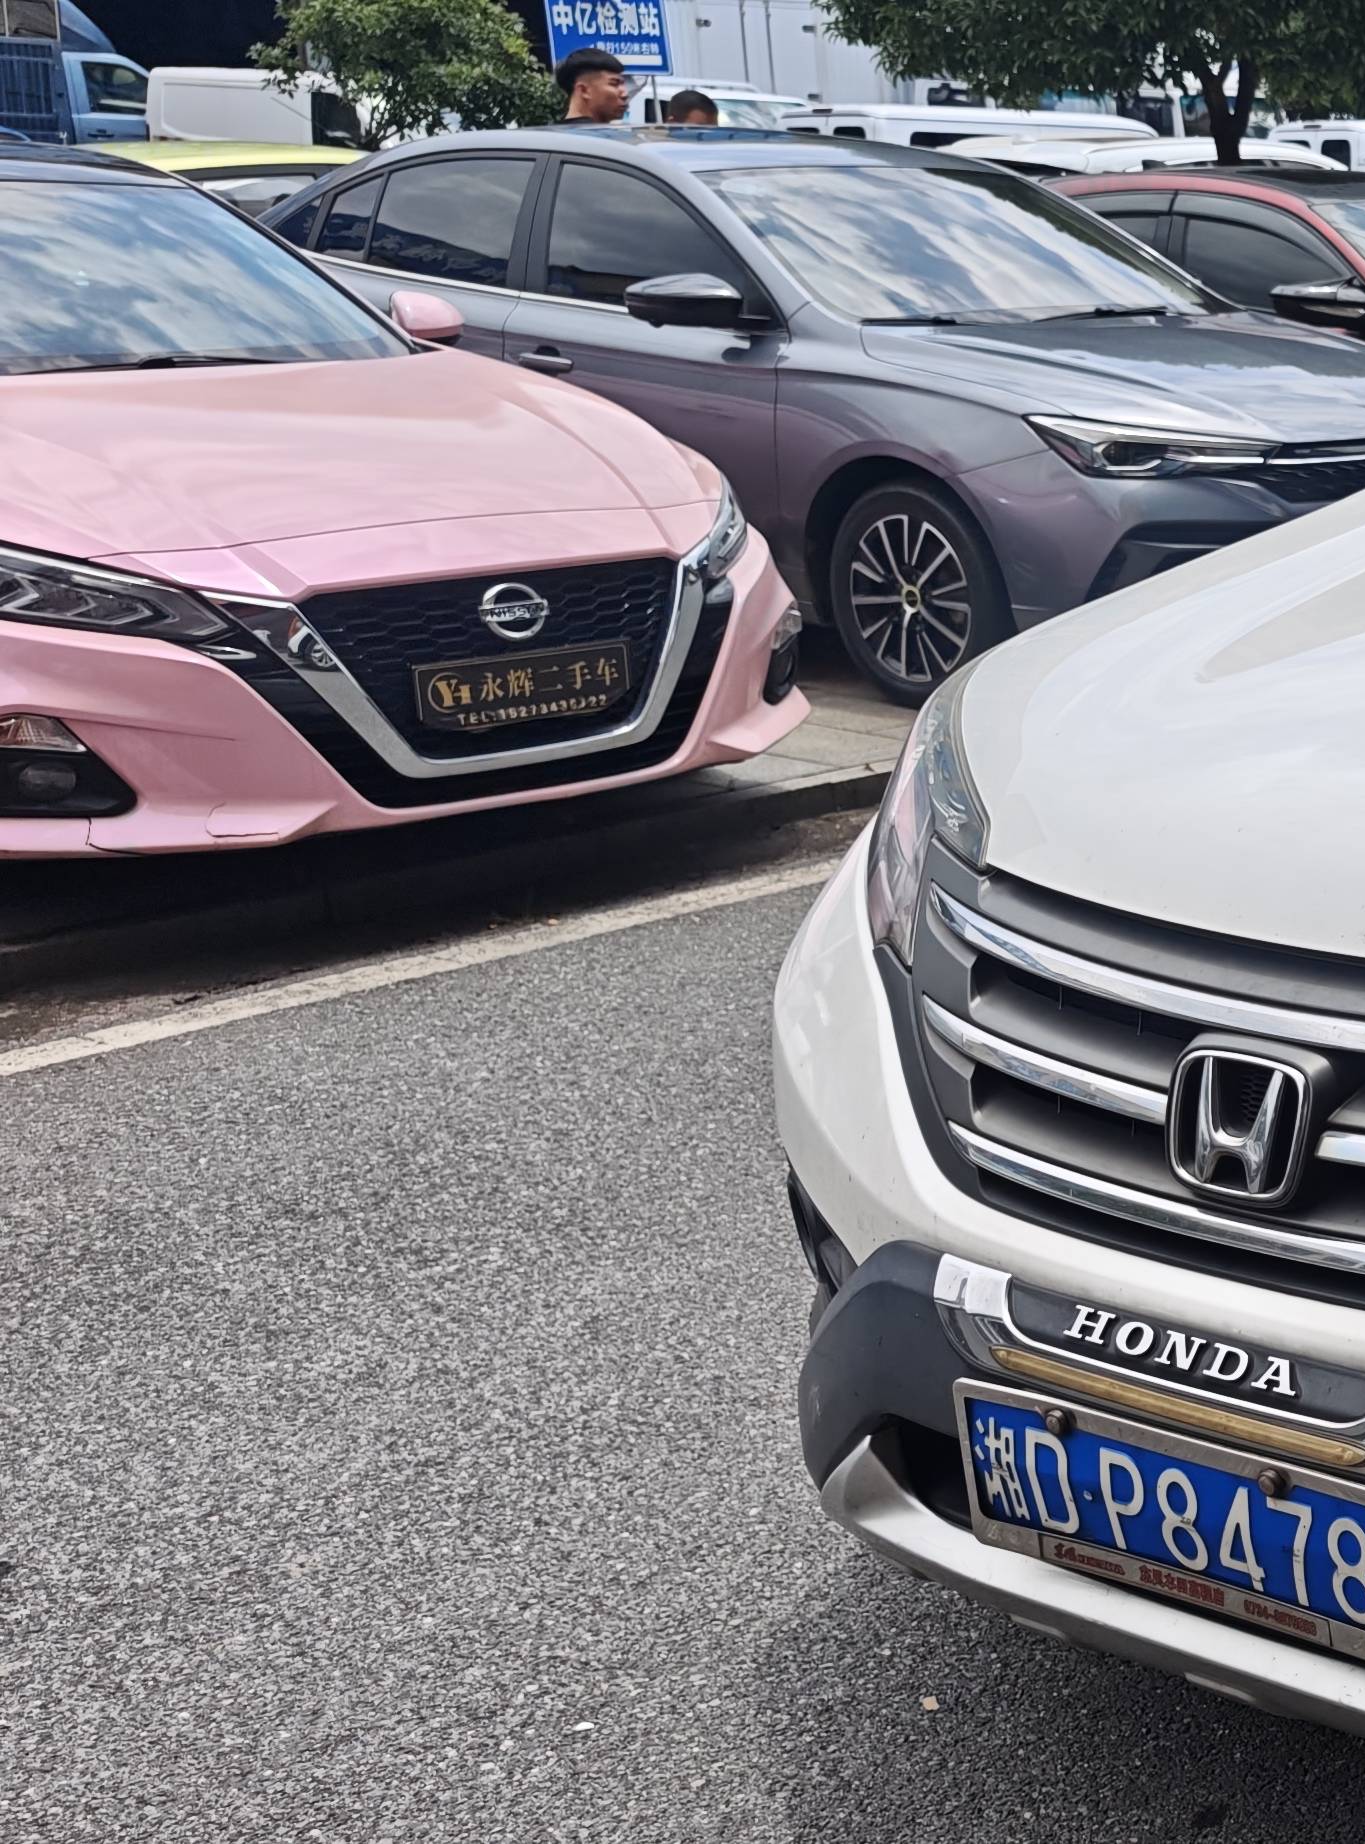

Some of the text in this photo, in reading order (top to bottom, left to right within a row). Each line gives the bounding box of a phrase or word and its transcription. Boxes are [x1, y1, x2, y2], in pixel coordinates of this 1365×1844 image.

[551, 1, 661, 37] 中亿检测站
[480, 657, 620, 702] 永辉二手车
[1063, 1304, 1298, 1397] HONDA
